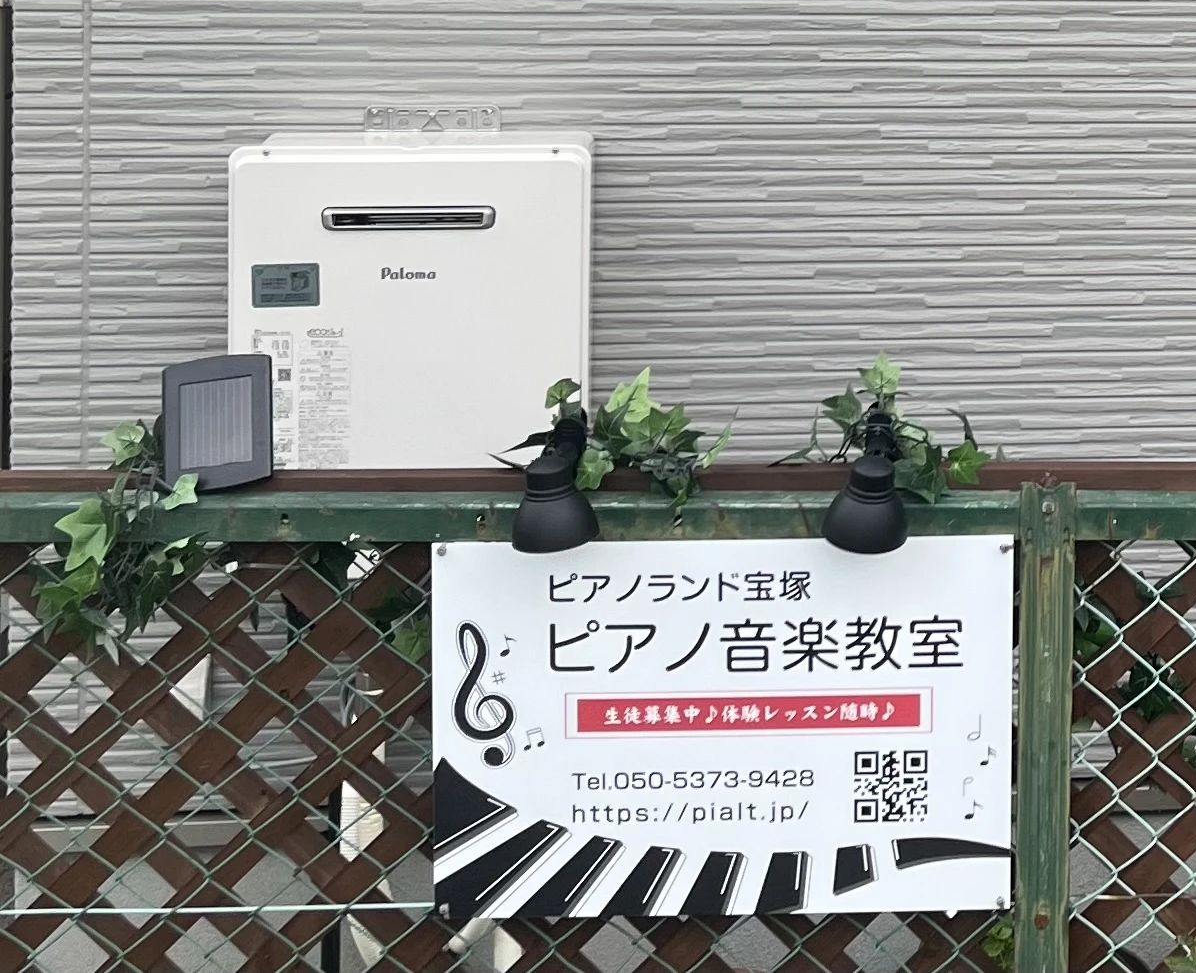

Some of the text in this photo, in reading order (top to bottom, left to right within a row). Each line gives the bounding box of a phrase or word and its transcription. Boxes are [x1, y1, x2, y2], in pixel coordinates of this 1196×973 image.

[381, 266, 437, 281] Paloma
[549, 570, 811, 603] ピアノランド宝塚
[549, 614, 964, 674] ピアノ音楽教室
[571, 769, 815, 792] Tel.050-5373-9428
[571, 801, 811, 825] https://pialt.jp/
